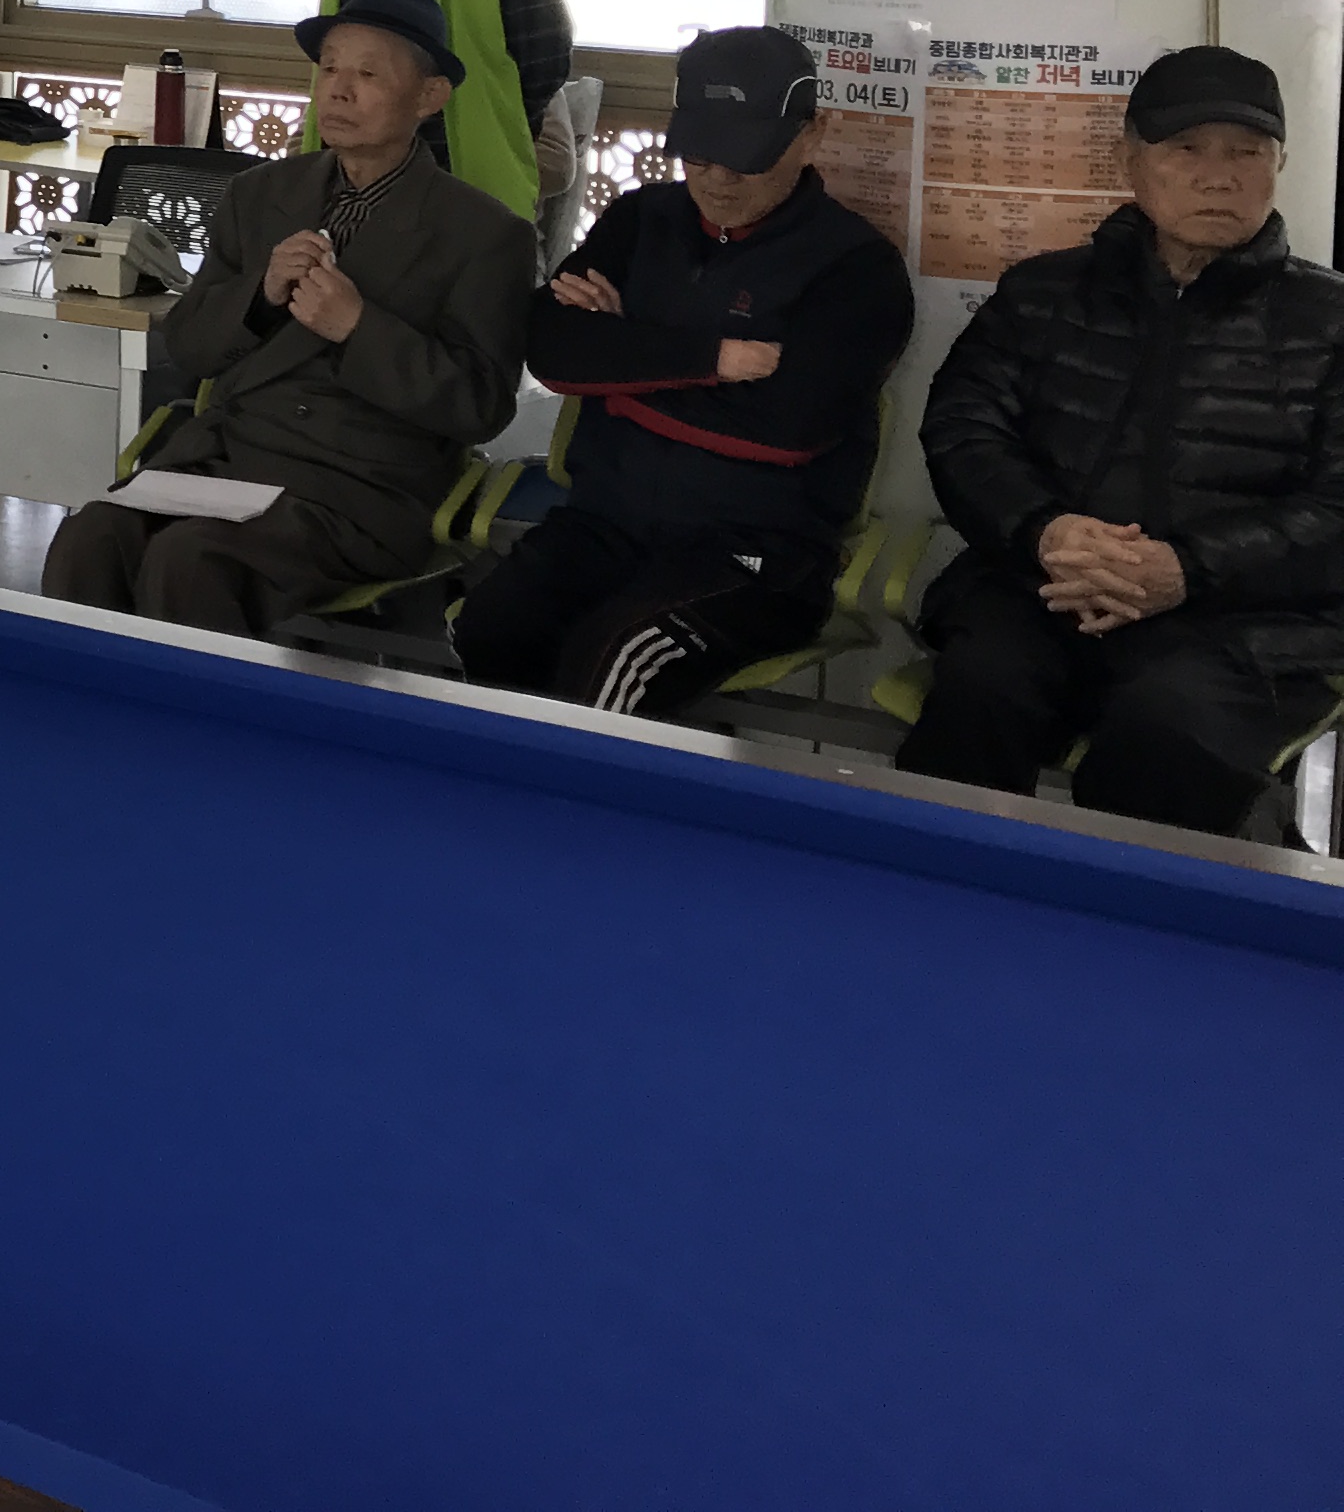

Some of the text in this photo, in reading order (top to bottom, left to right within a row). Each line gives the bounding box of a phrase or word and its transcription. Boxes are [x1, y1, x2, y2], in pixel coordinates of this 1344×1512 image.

[928, 38, 1099, 63] 중림종합사회복지관과
[995, 65, 1031, 85] 알찬
[1036, 63, 1081, 87] 저녁
